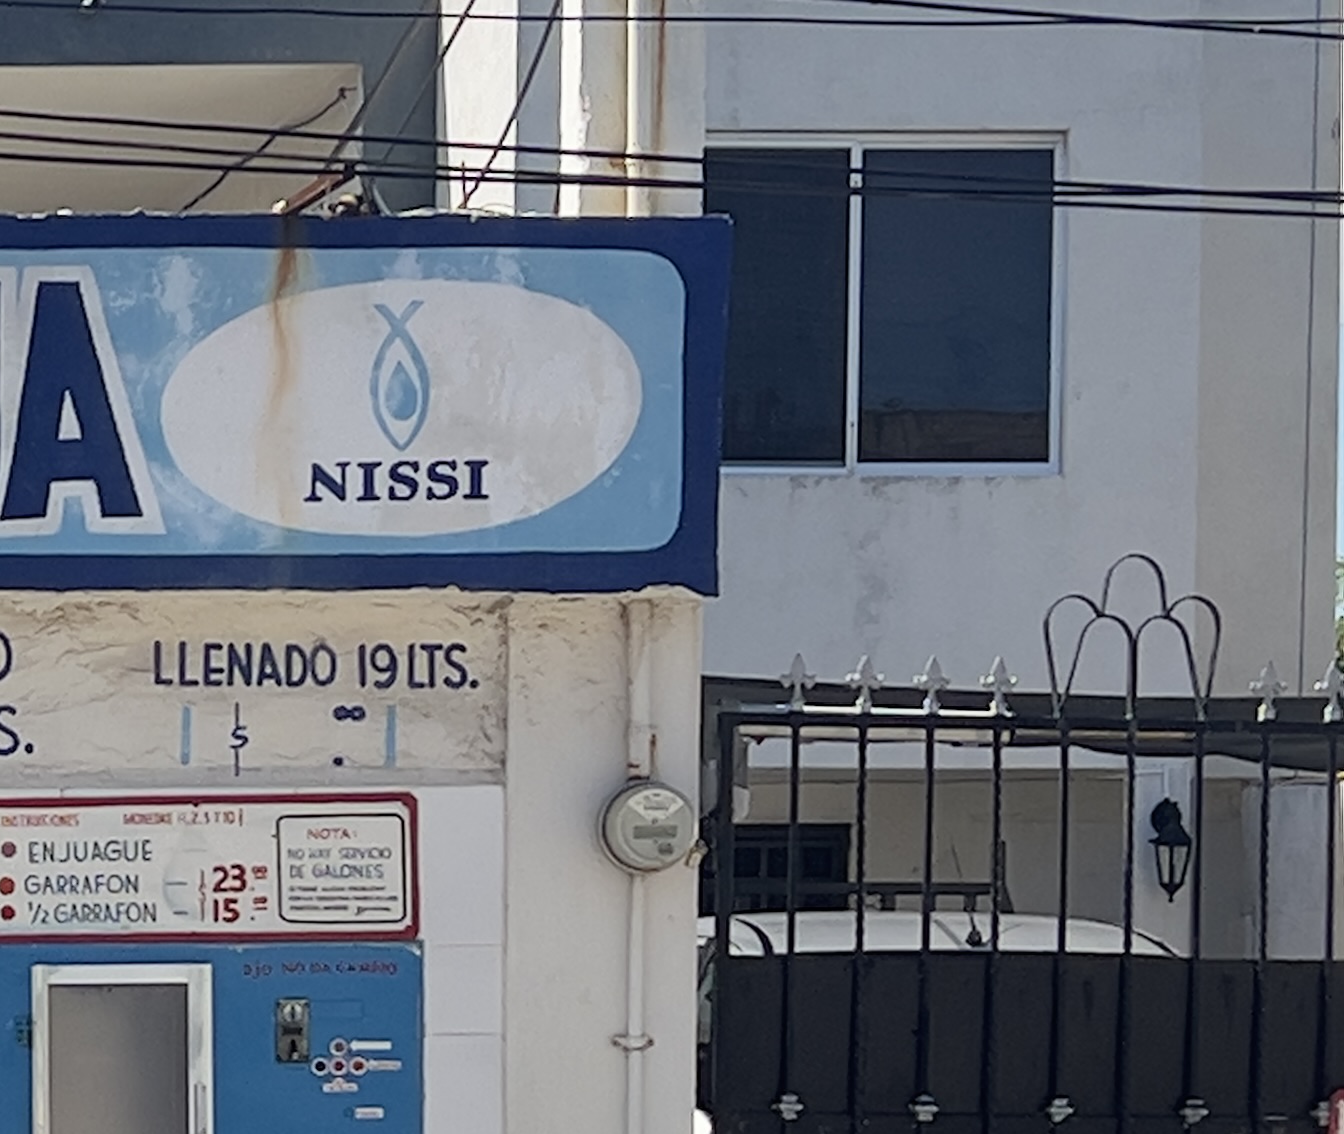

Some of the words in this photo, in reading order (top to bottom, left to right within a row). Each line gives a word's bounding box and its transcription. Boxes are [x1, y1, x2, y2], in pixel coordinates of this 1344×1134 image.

[304, 459, 491, 503] NISSI
[153, 640, 338, 689] LLENADO
[27, 839, 153, 864] ENJUAGUE
[23, 874, 140, 896] GARRAFON
[53, 901, 158, 924] GARRAFON
